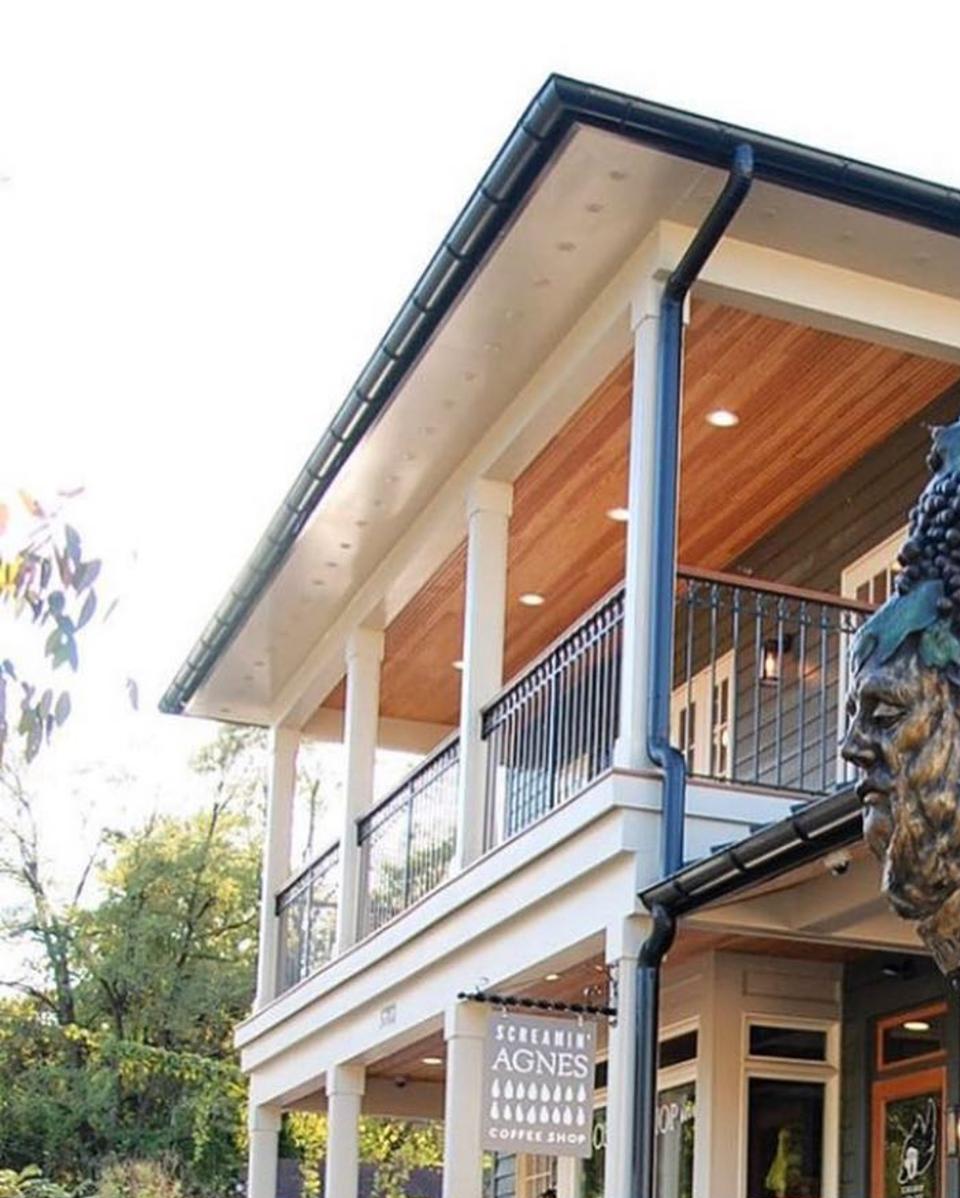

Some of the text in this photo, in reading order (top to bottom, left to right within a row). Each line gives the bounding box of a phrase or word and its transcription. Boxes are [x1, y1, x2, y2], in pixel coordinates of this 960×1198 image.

[495, 1025, 592, 1049] SCREAMIN'
[491, 1047, 589, 1079] AGNES
[488, 1127, 543, 1143] COFFEE
[547, 1131, 587, 1145] SHOP
